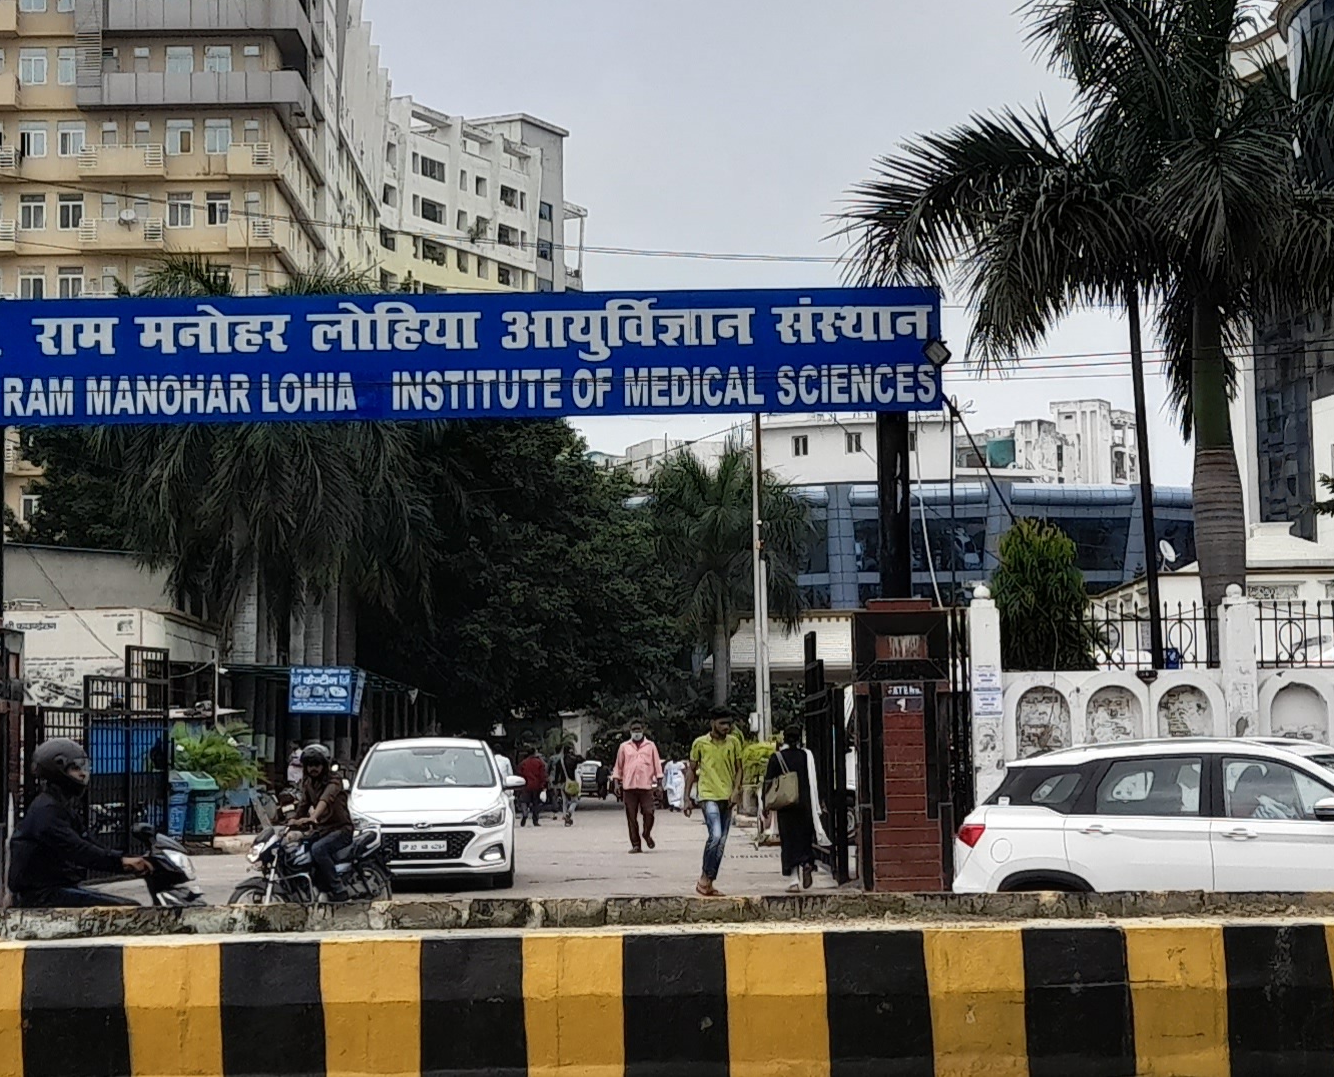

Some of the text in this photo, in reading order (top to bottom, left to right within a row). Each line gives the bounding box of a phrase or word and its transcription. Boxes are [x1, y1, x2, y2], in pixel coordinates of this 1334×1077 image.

[31, 317, 119, 355] राम
[134, 304, 291, 354] मनोहर
[306, 302, 481, 352] लोहिया
[501, 297, 755, 362] आयुर्विज्ञान
[771, 297, 933, 344] संस्थान
[3, 376, 74, 417] RAM
[85, 374, 252, 415] MANOHAR
[262, 372, 357, 413] LOHIA
[392, 368, 563, 412] INSTITUTE
[572, 367, 613, 410] OF
[624, 365, 765, 407] MEDICAL
[776, 363, 937, 405] SCIENCES
